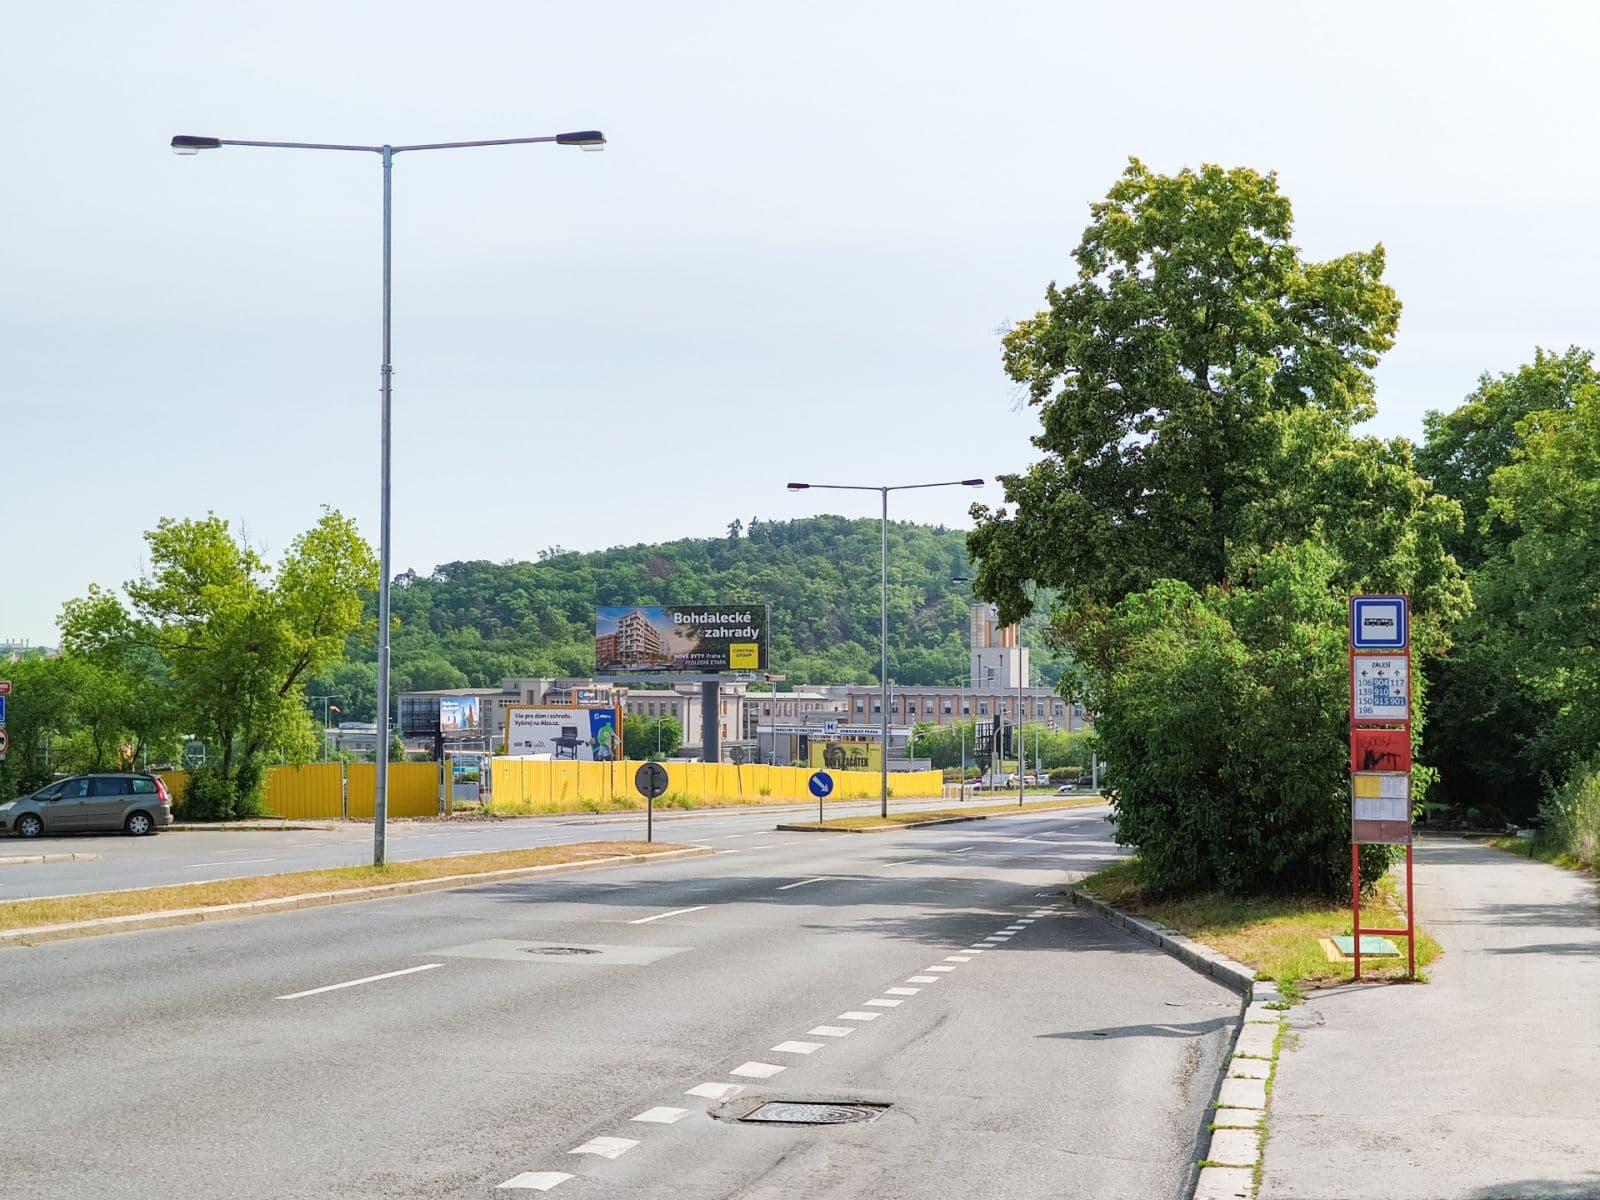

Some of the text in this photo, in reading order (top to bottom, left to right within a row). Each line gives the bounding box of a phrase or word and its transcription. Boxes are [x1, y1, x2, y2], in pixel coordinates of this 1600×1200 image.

[673, 611, 752, 624] Bohdalecké
[704, 627, 760, 640] zahrady
[1358, 679, 1405, 687] 106 904 117
[1358, 688, 1389, 696] 139 910
[1358, 697, 1373, 705] 150
[1390, 697, 1405, 705] 901
